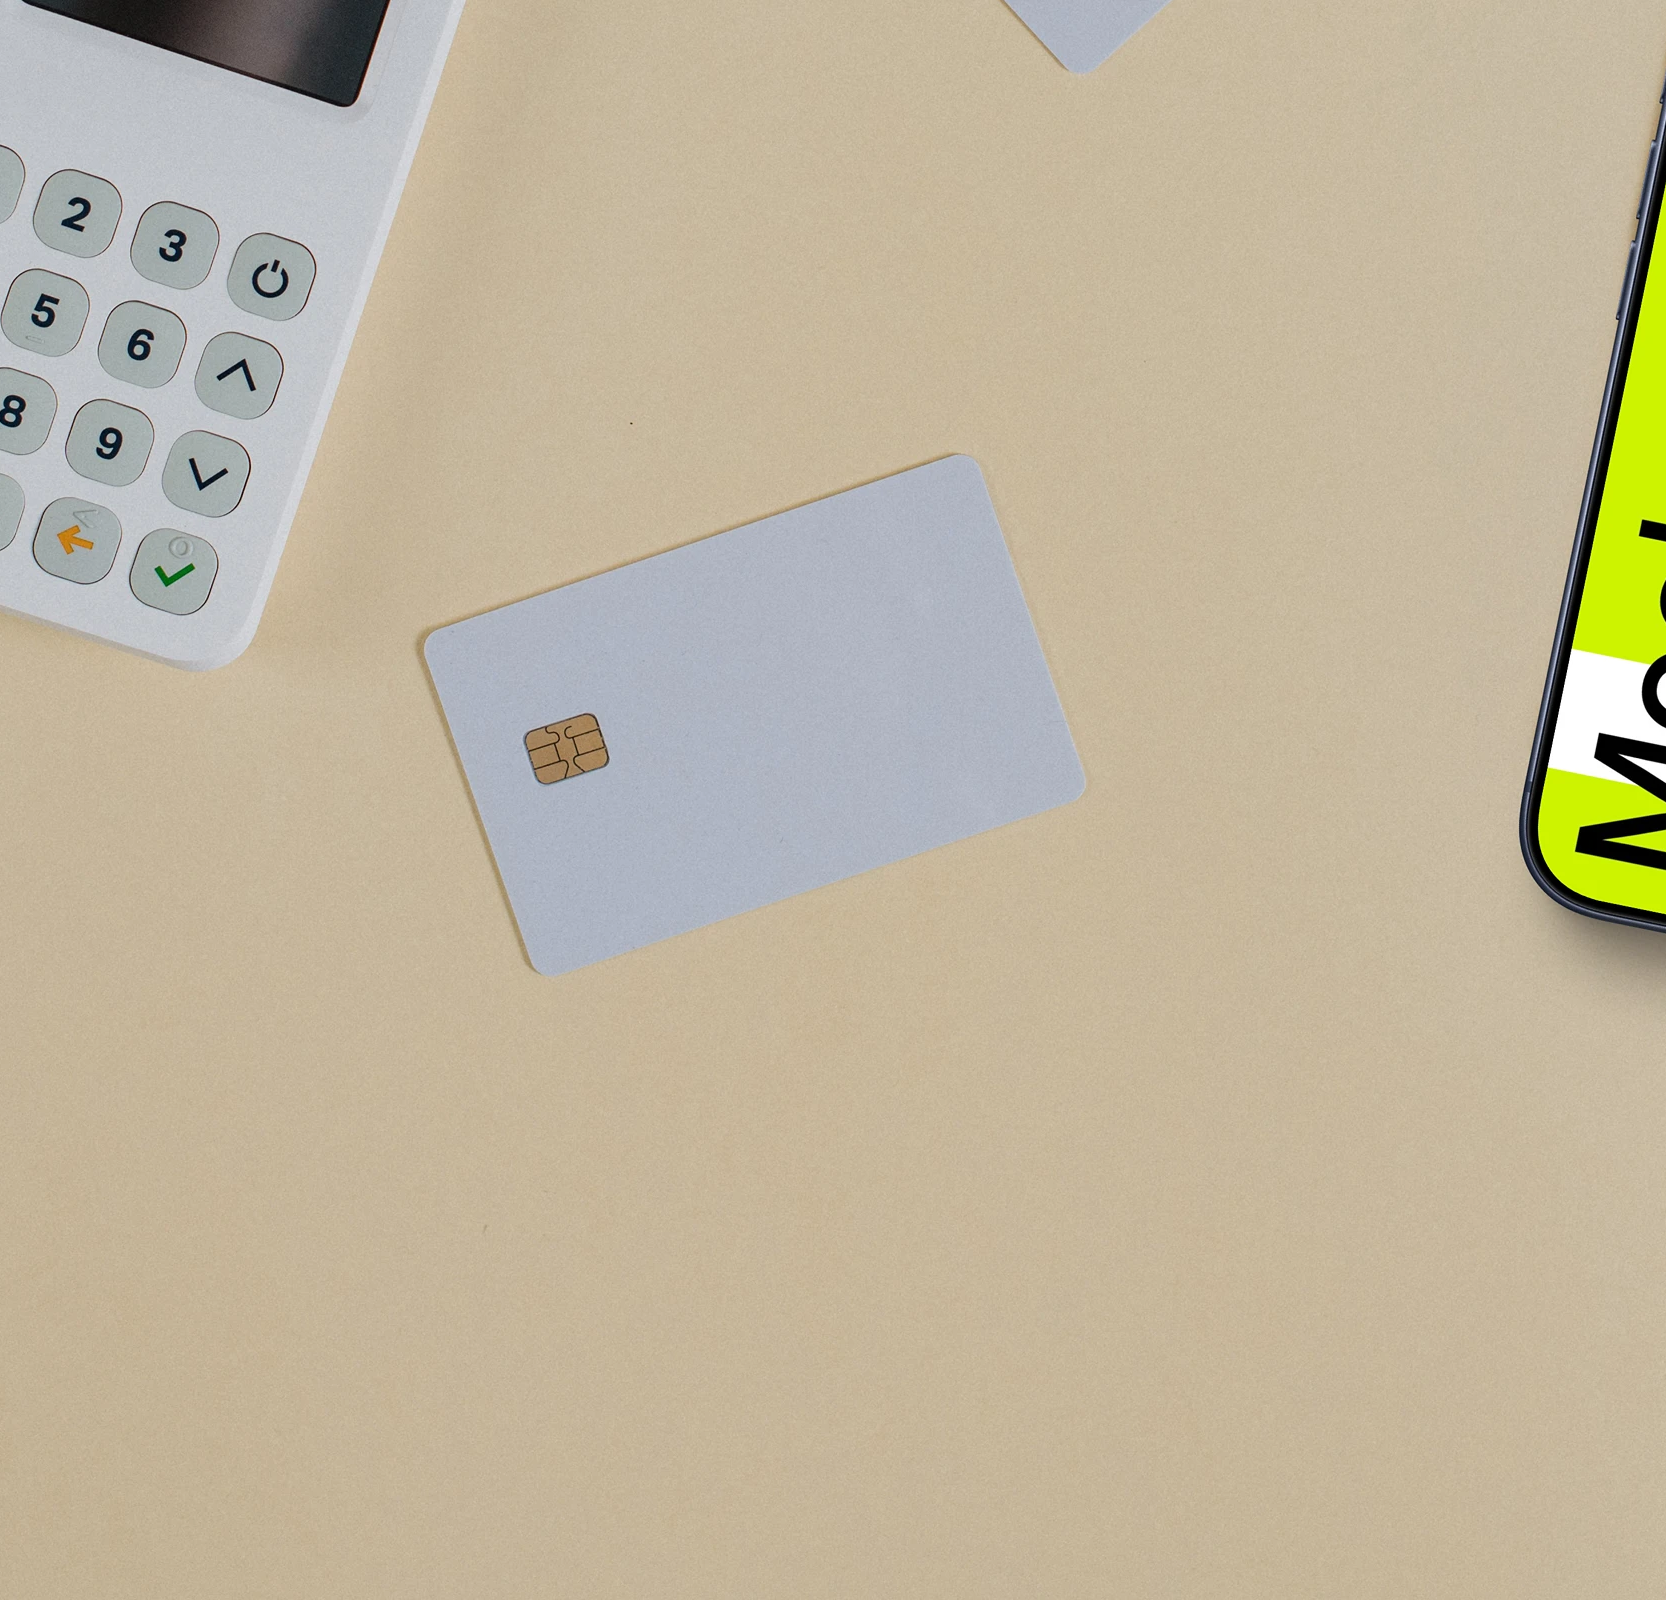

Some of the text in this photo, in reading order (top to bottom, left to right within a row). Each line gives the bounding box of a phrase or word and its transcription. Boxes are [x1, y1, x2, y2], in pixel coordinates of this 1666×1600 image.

[60, 196, 92, 233] 2
[158, 228, 187, 263] 3
[30, 293, 60, 328] 5
[127, 328, 155, 361] 6
[95, 427, 123, 460] 9
